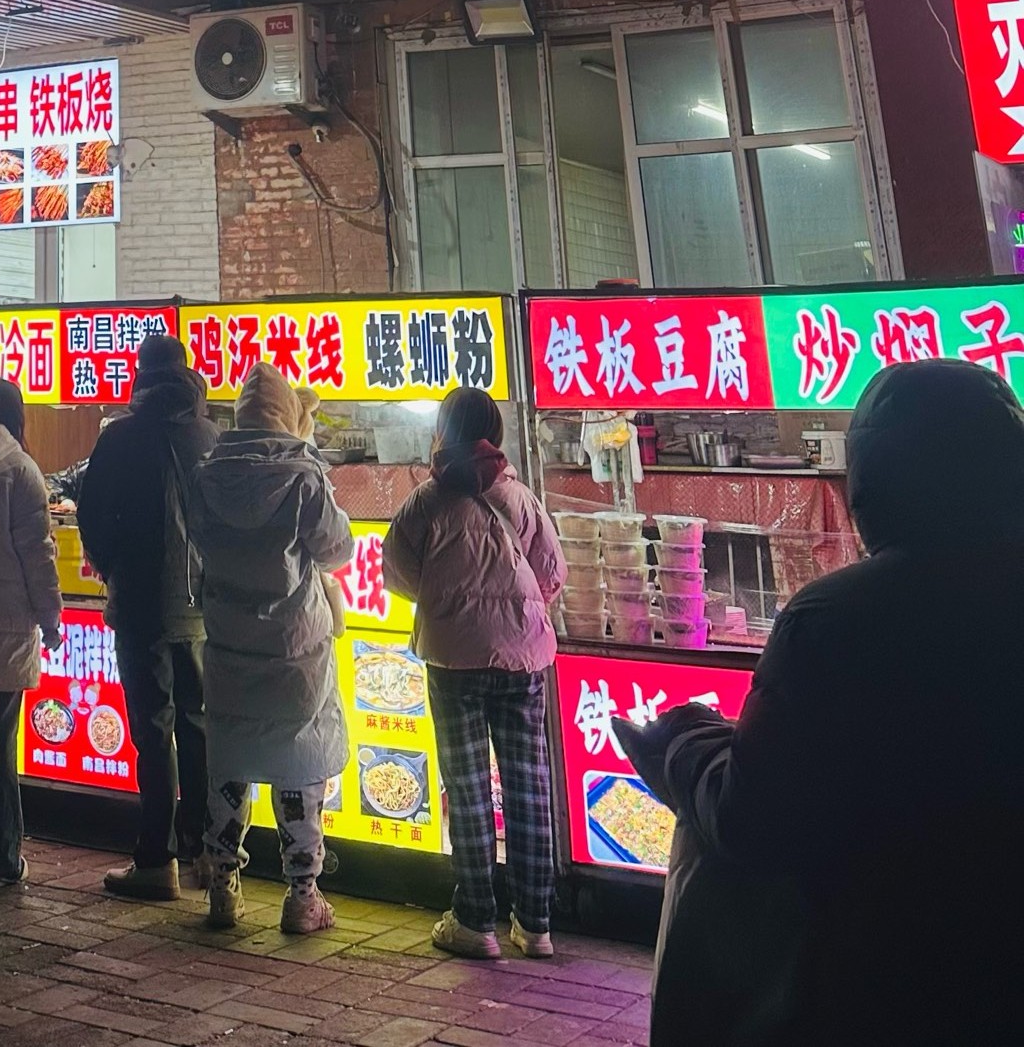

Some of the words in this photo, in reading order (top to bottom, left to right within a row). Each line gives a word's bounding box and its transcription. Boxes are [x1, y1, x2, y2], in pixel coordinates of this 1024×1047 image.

[269, 22, 290, 30] TCL
[30, 68, 113, 137] 铁板烧
[187, 314, 345, 389] 鸡汤米线
[364, 309, 494, 389] 螺蛳粉
[544, 309, 749, 401] 铁板豆腐
[74, 361, 138, 396] 热干
[365, 714, 418, 733] 麻酱米线
[574, 679, 720, 760] 铁板
[371, 819, 423, 842] 热干面
